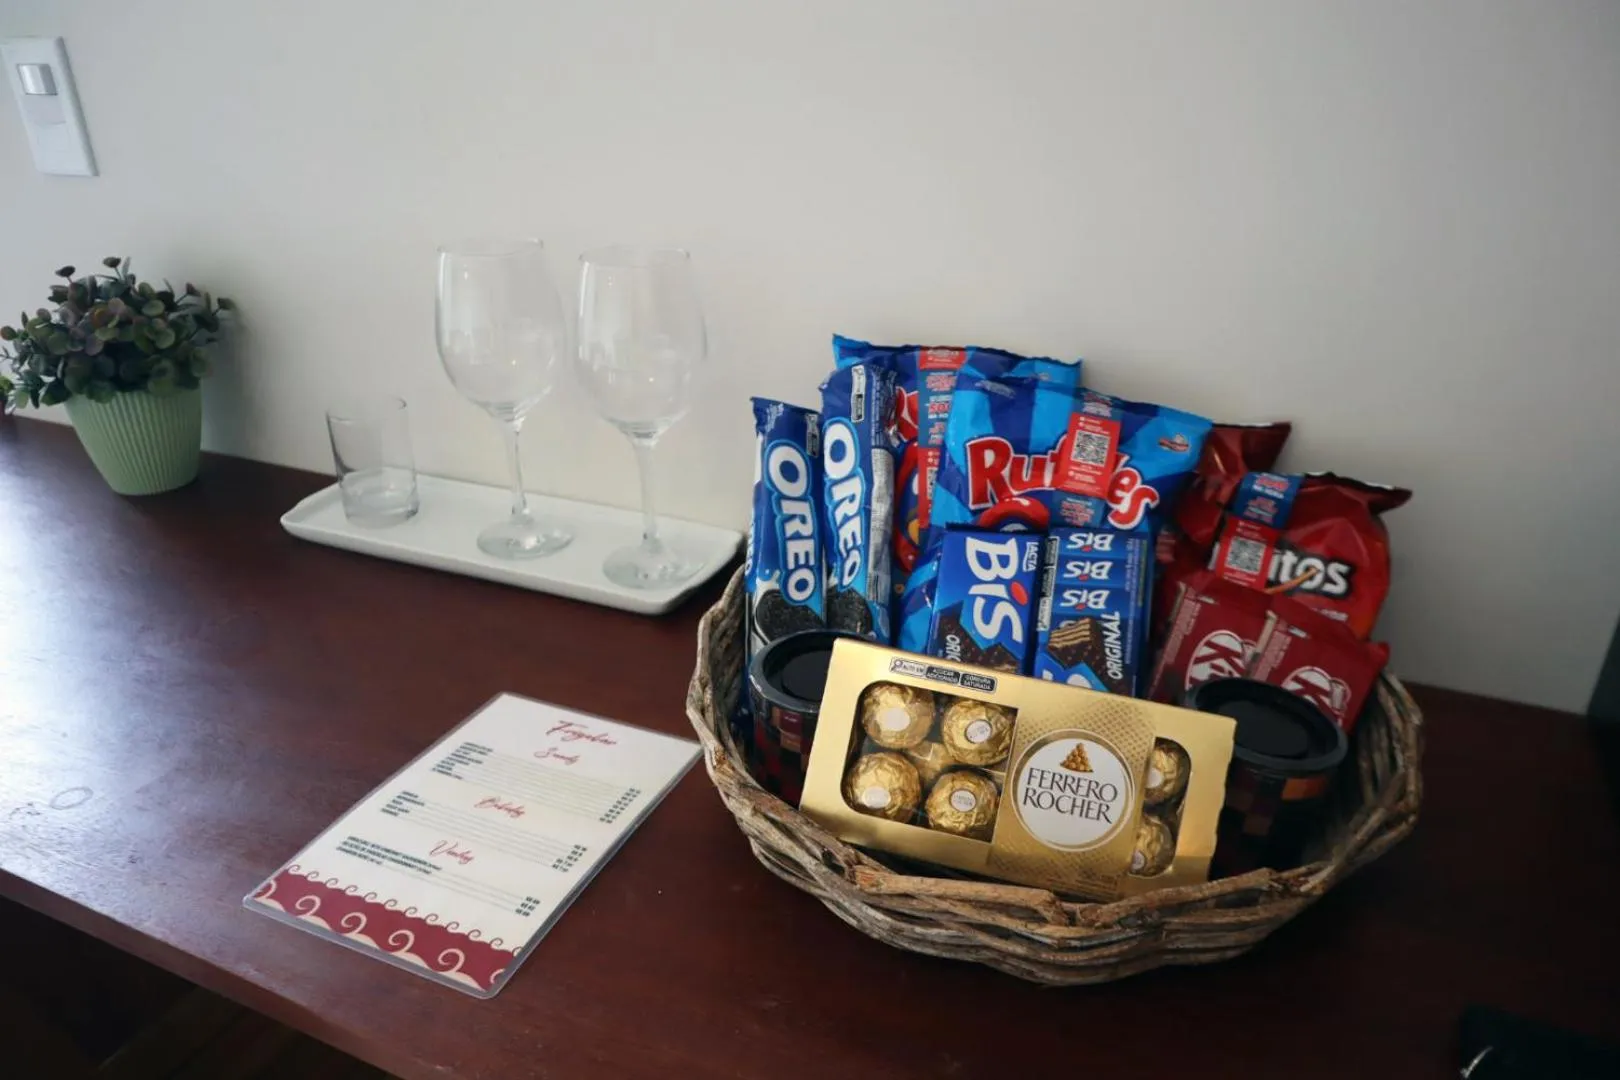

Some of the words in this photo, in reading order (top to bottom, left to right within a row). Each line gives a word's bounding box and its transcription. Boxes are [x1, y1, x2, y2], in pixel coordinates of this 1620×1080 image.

[769, 445, 815, 601] OREO
[824, 423, 862, 586] OREO
[1022, 541, 1039, 572] LACTA
[1101, 611, 1124, 680] ORIGINAL
[1023, 787, 1112, 824] ROCHER
[1026, 767, 1118, 803] FERRERO
